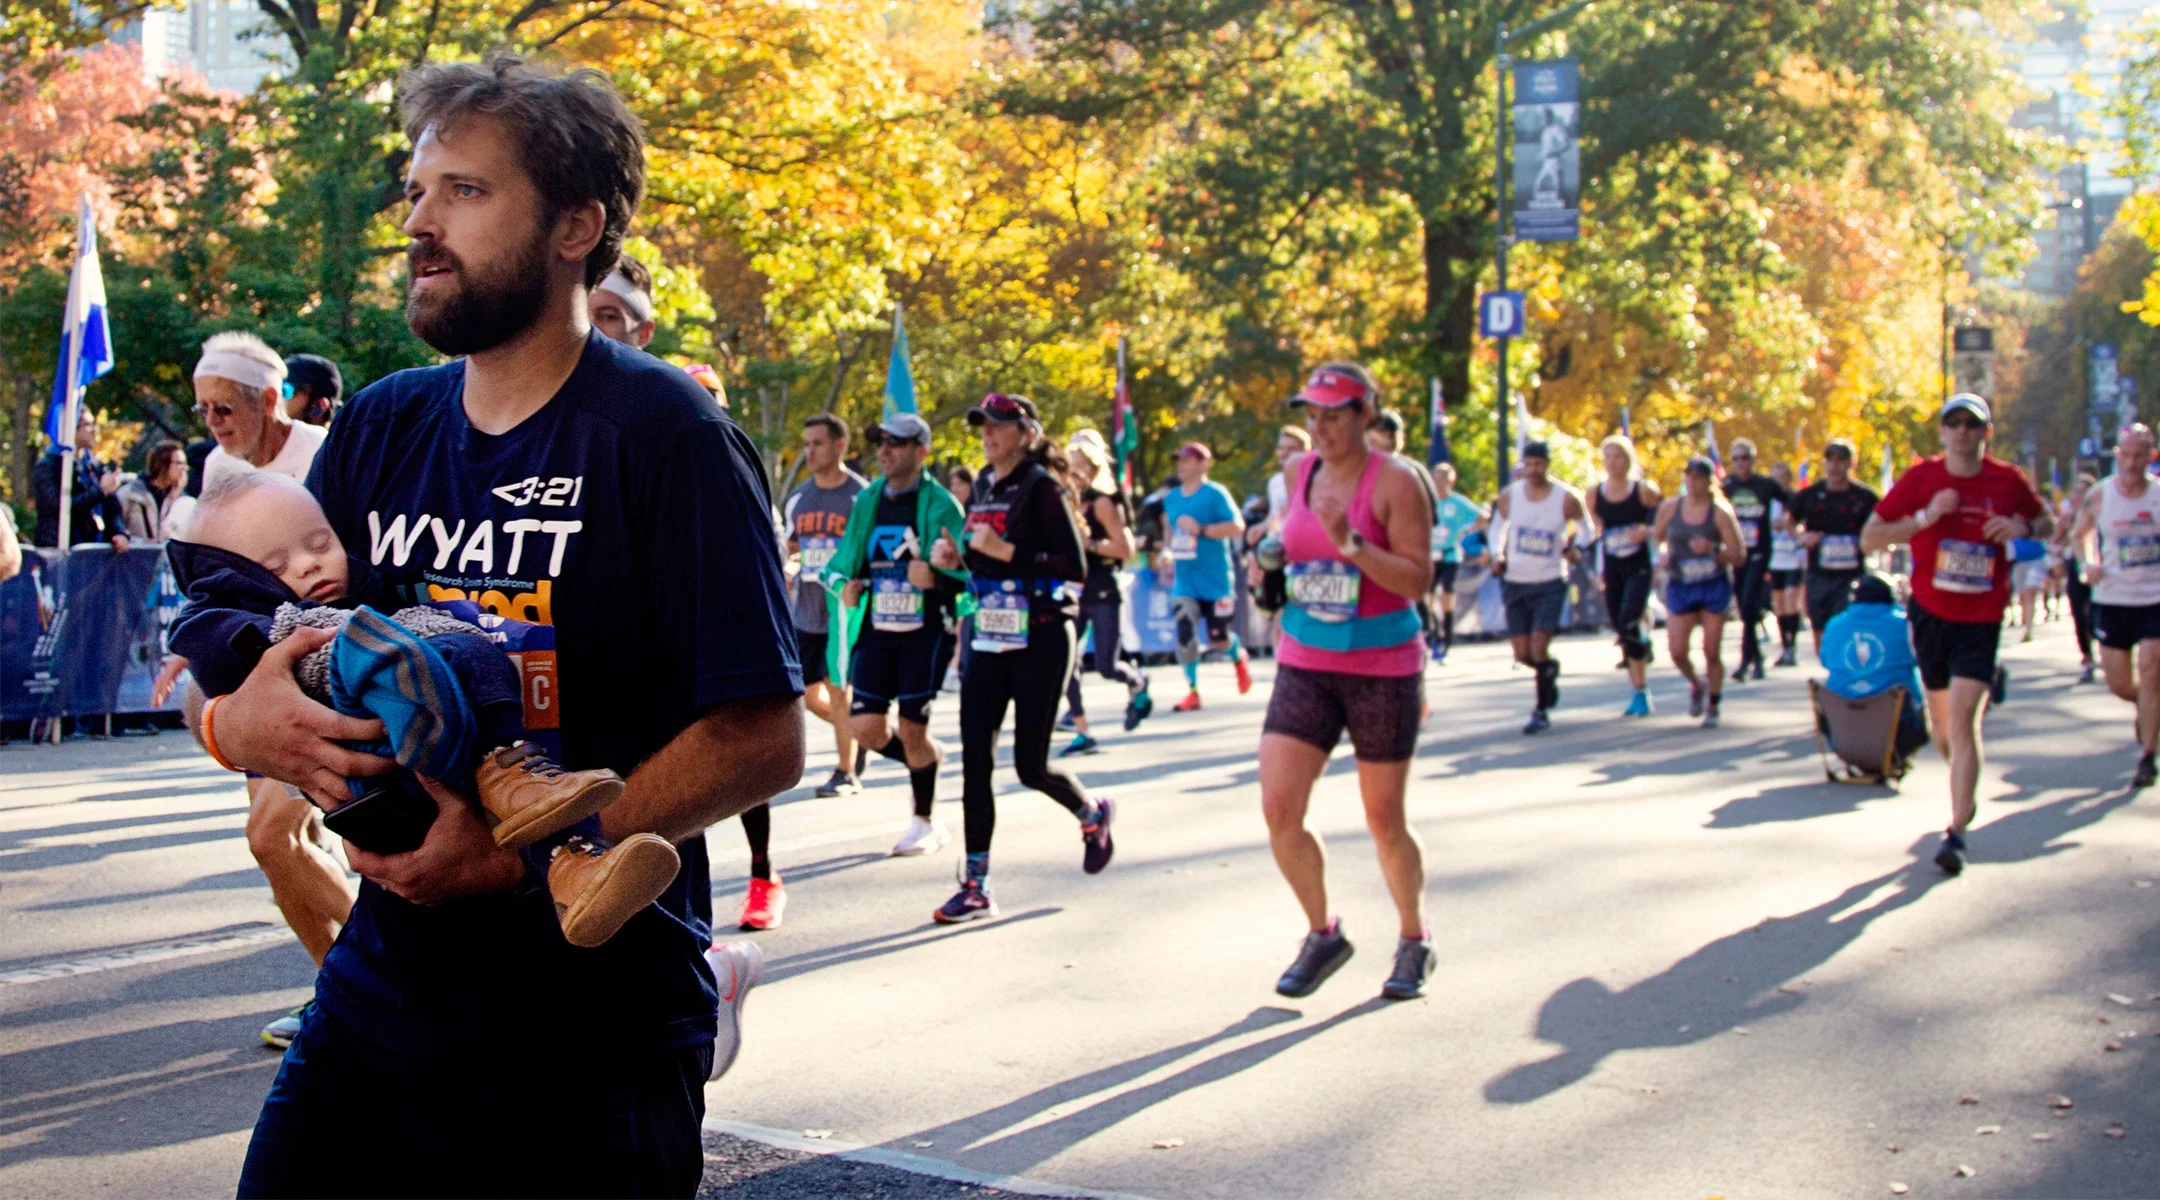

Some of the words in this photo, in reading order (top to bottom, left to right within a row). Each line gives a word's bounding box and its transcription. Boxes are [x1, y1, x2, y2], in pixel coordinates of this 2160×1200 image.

[1488, 296, 1514, 332] D
[367, 510, 583, 578] WYATT
[484, 576, 535, 590] Syndrome
[531, 674, 551, 710] C
